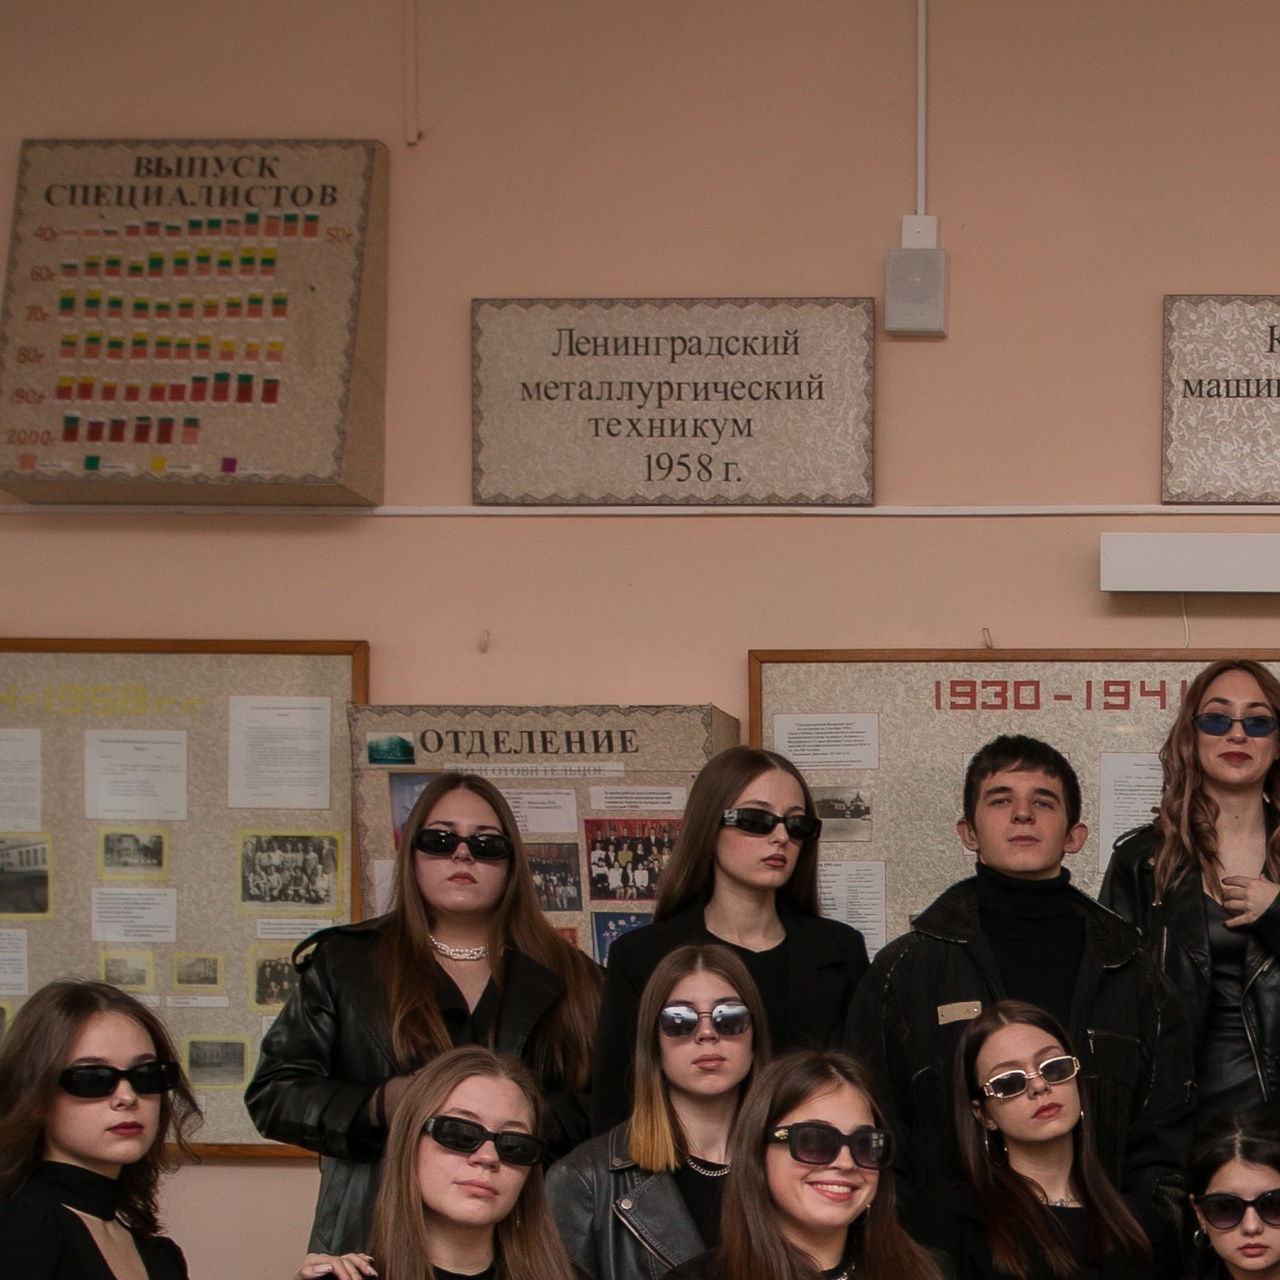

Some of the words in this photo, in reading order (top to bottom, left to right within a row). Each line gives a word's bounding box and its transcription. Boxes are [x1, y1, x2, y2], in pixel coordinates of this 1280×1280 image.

[133, 155, 282, 179] ВЫПУСК
[44, 183, 339, 211] СПЕЦИАЛИСТОВ
[552, 328, 801, 364] Ленинградский
[519, 374, 826, 409] металлургический
[588, 417, 754, 446] техникум
[643, 453, 714, 483] 1958
[722, 462, 743, 482] г.
[419, 729, 641, 759] ОТДЕЛЕНИЕ
